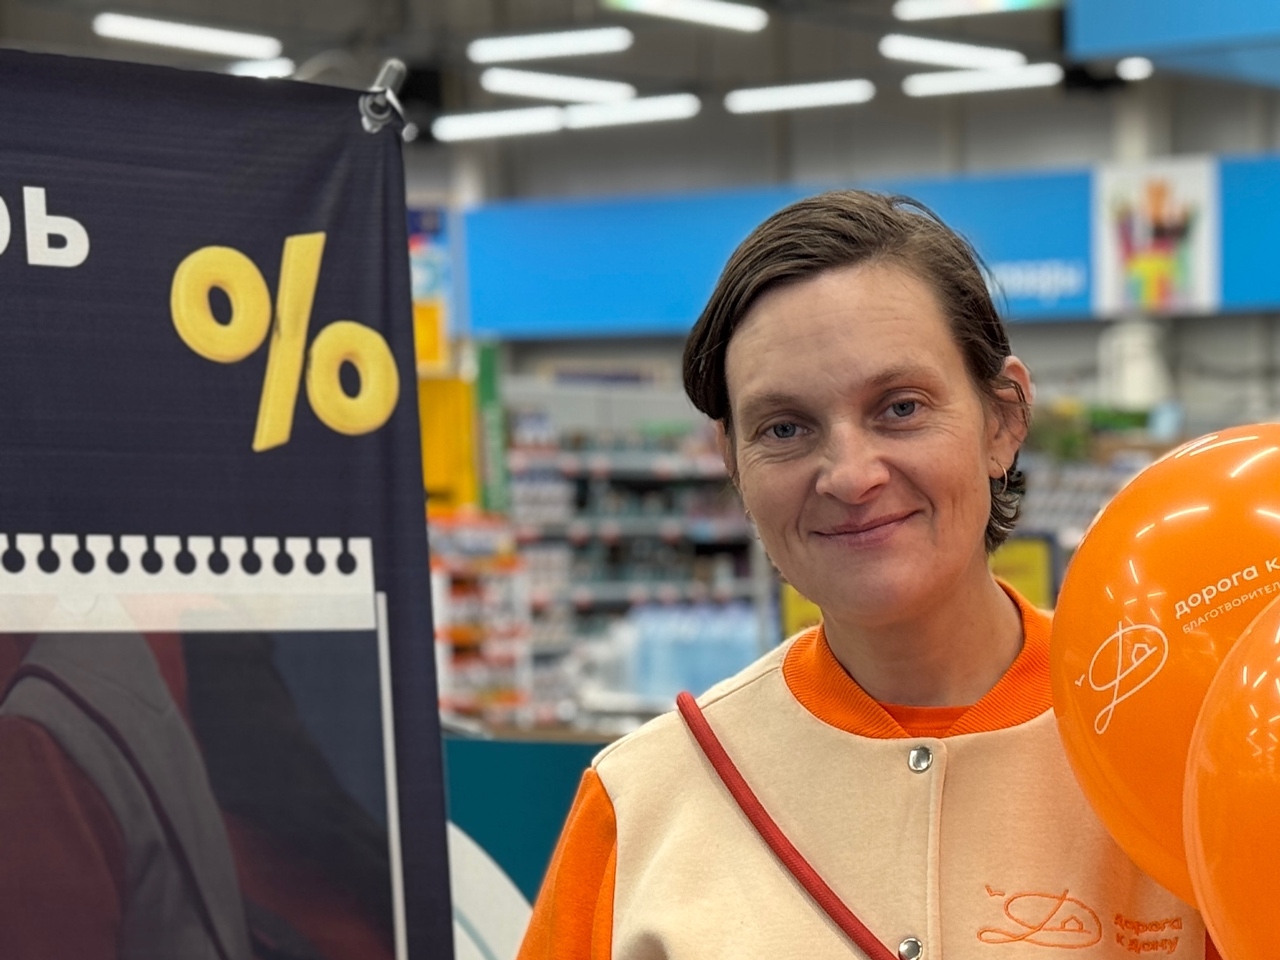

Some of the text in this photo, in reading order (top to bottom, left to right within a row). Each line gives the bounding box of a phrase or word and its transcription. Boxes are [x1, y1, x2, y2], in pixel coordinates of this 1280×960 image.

[0, 186, 90, 267] ь
[1175, 565, 1259, 620] дорога
[1265, 557, 1280, 572] к
